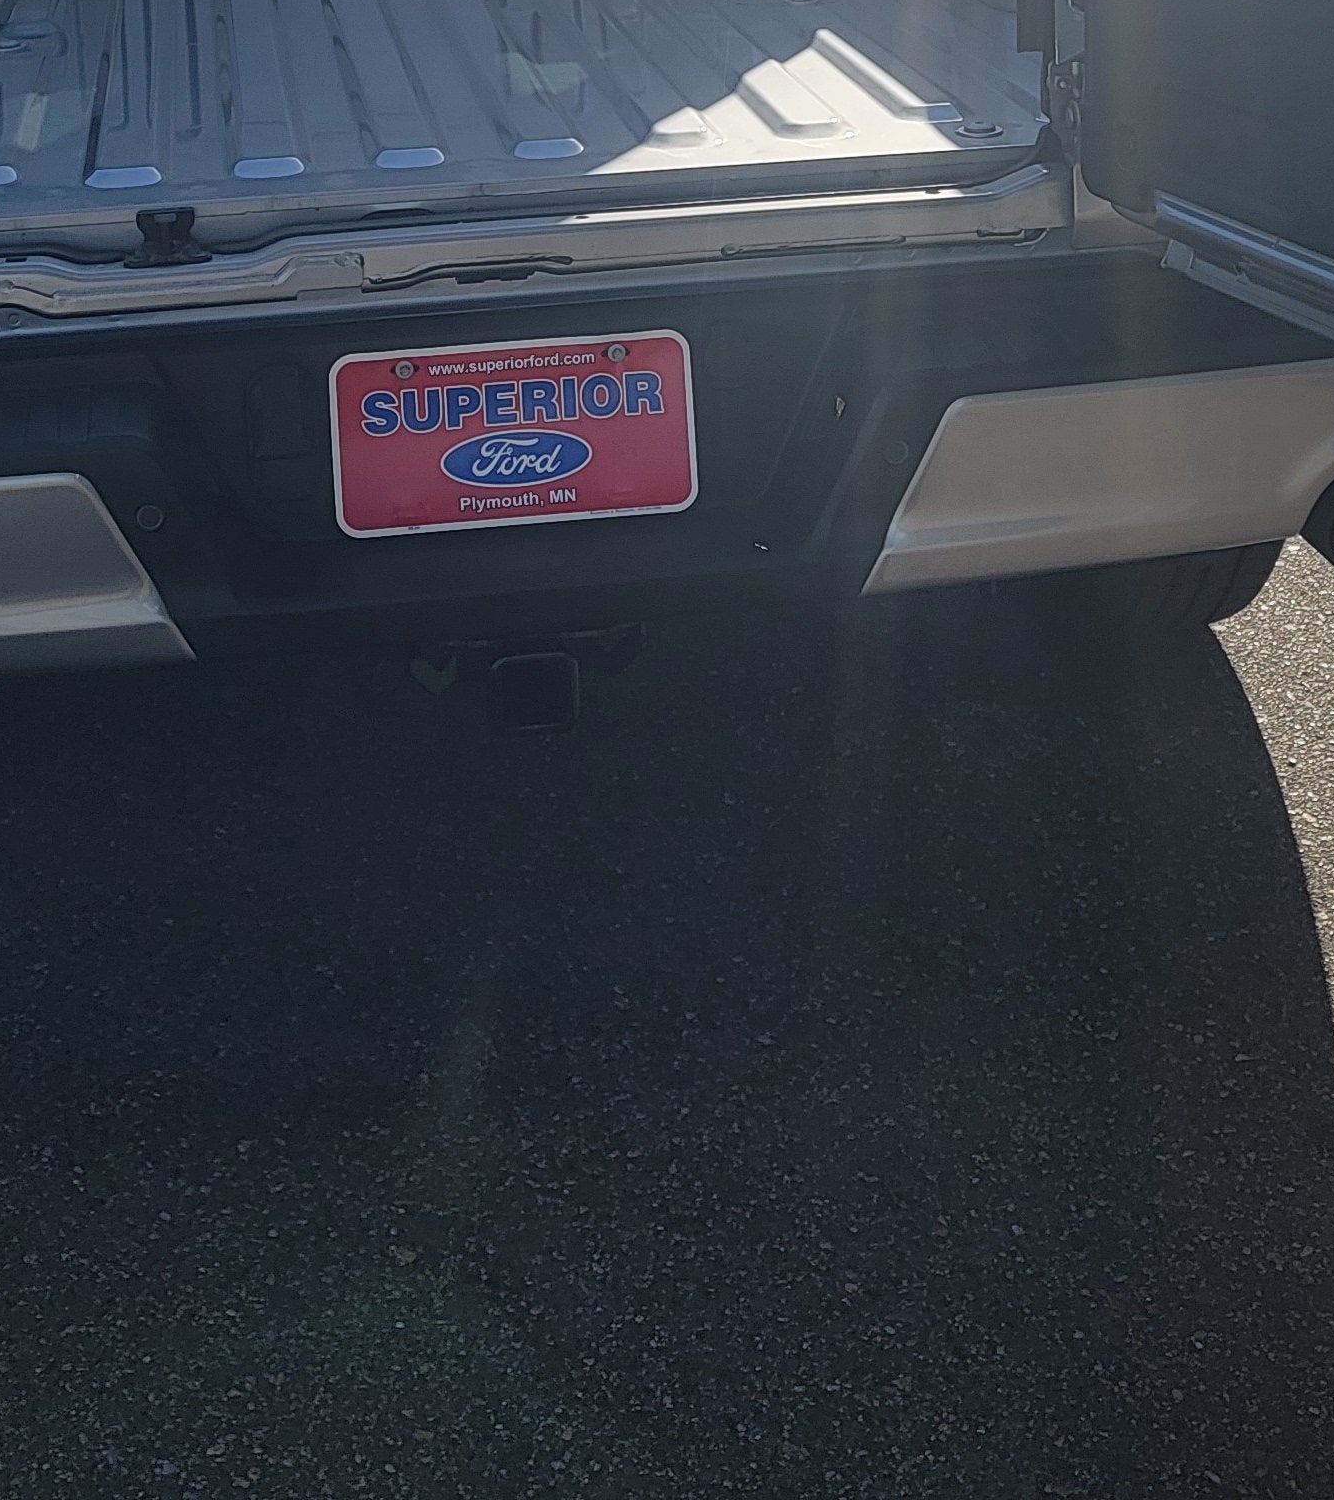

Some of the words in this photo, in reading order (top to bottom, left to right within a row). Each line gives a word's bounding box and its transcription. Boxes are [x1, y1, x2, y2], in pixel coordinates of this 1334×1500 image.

[427, 351, 596, 377] www.superiorford.com
[361, 371, 664, 437] SUPERIOR
[471, 437, 562, 477] Ford
[460, 492, 544, 512] Plymouth,
[549, 488, 577, 504] MN
